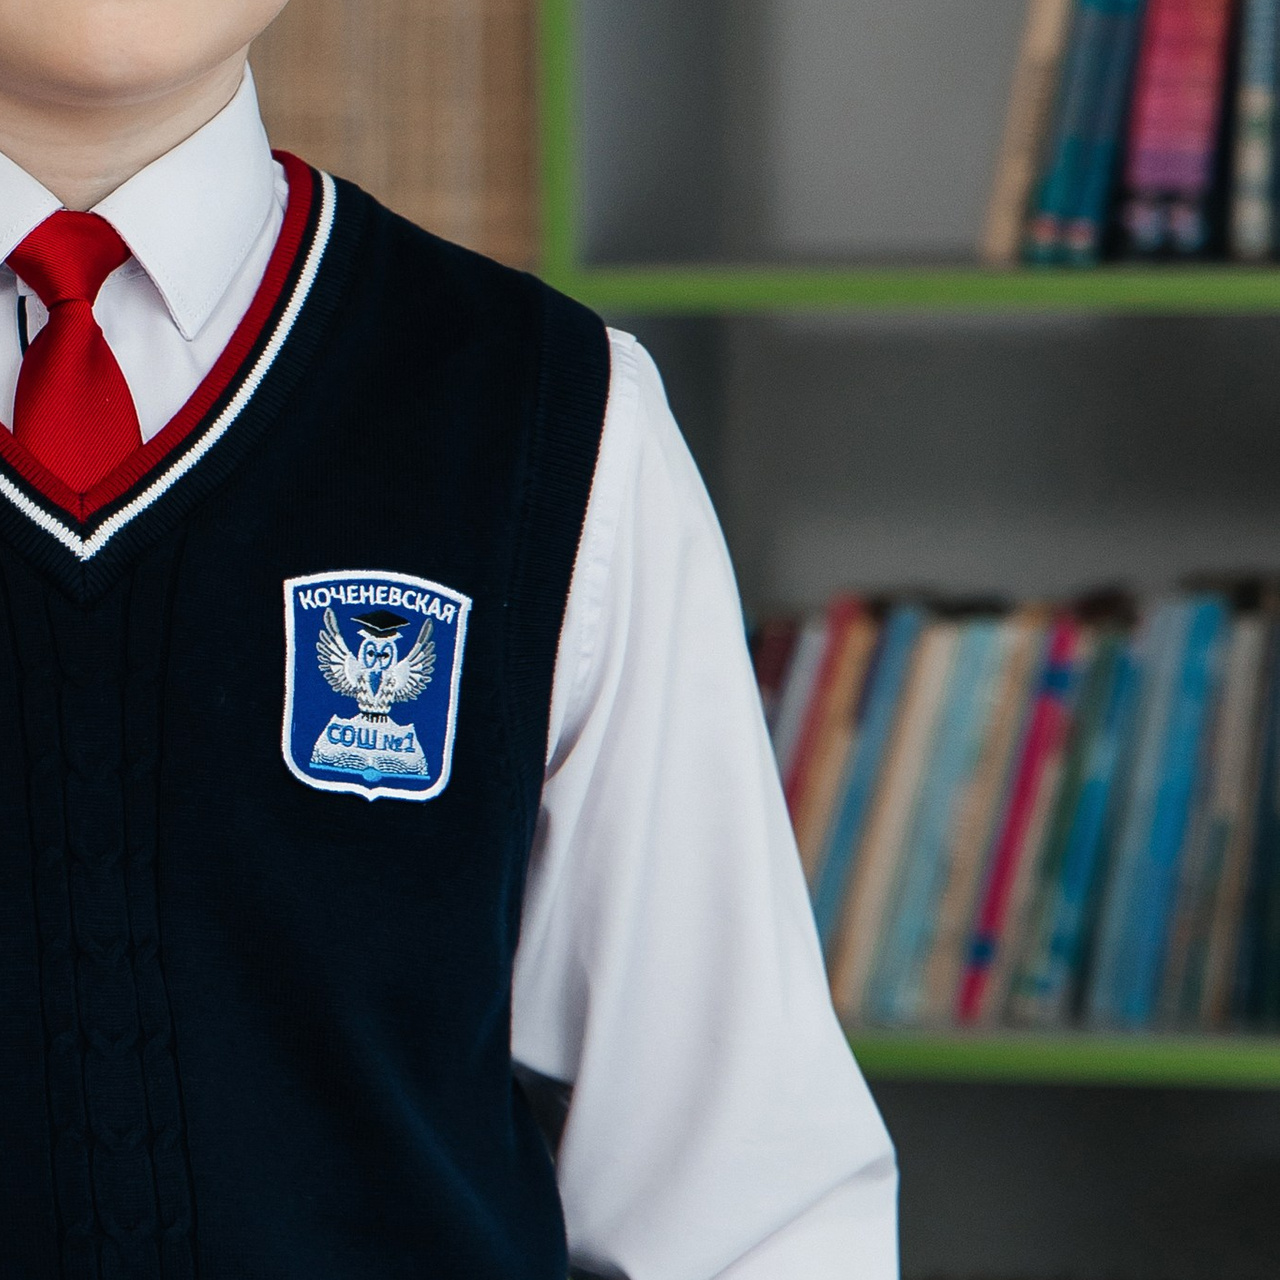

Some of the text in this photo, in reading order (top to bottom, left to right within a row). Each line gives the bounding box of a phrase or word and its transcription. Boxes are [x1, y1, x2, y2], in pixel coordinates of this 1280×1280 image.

[298, 585, 457, 624] КОЧЕНЕВСКАЯ
[327, 723, 416, 753] СОШ №1
